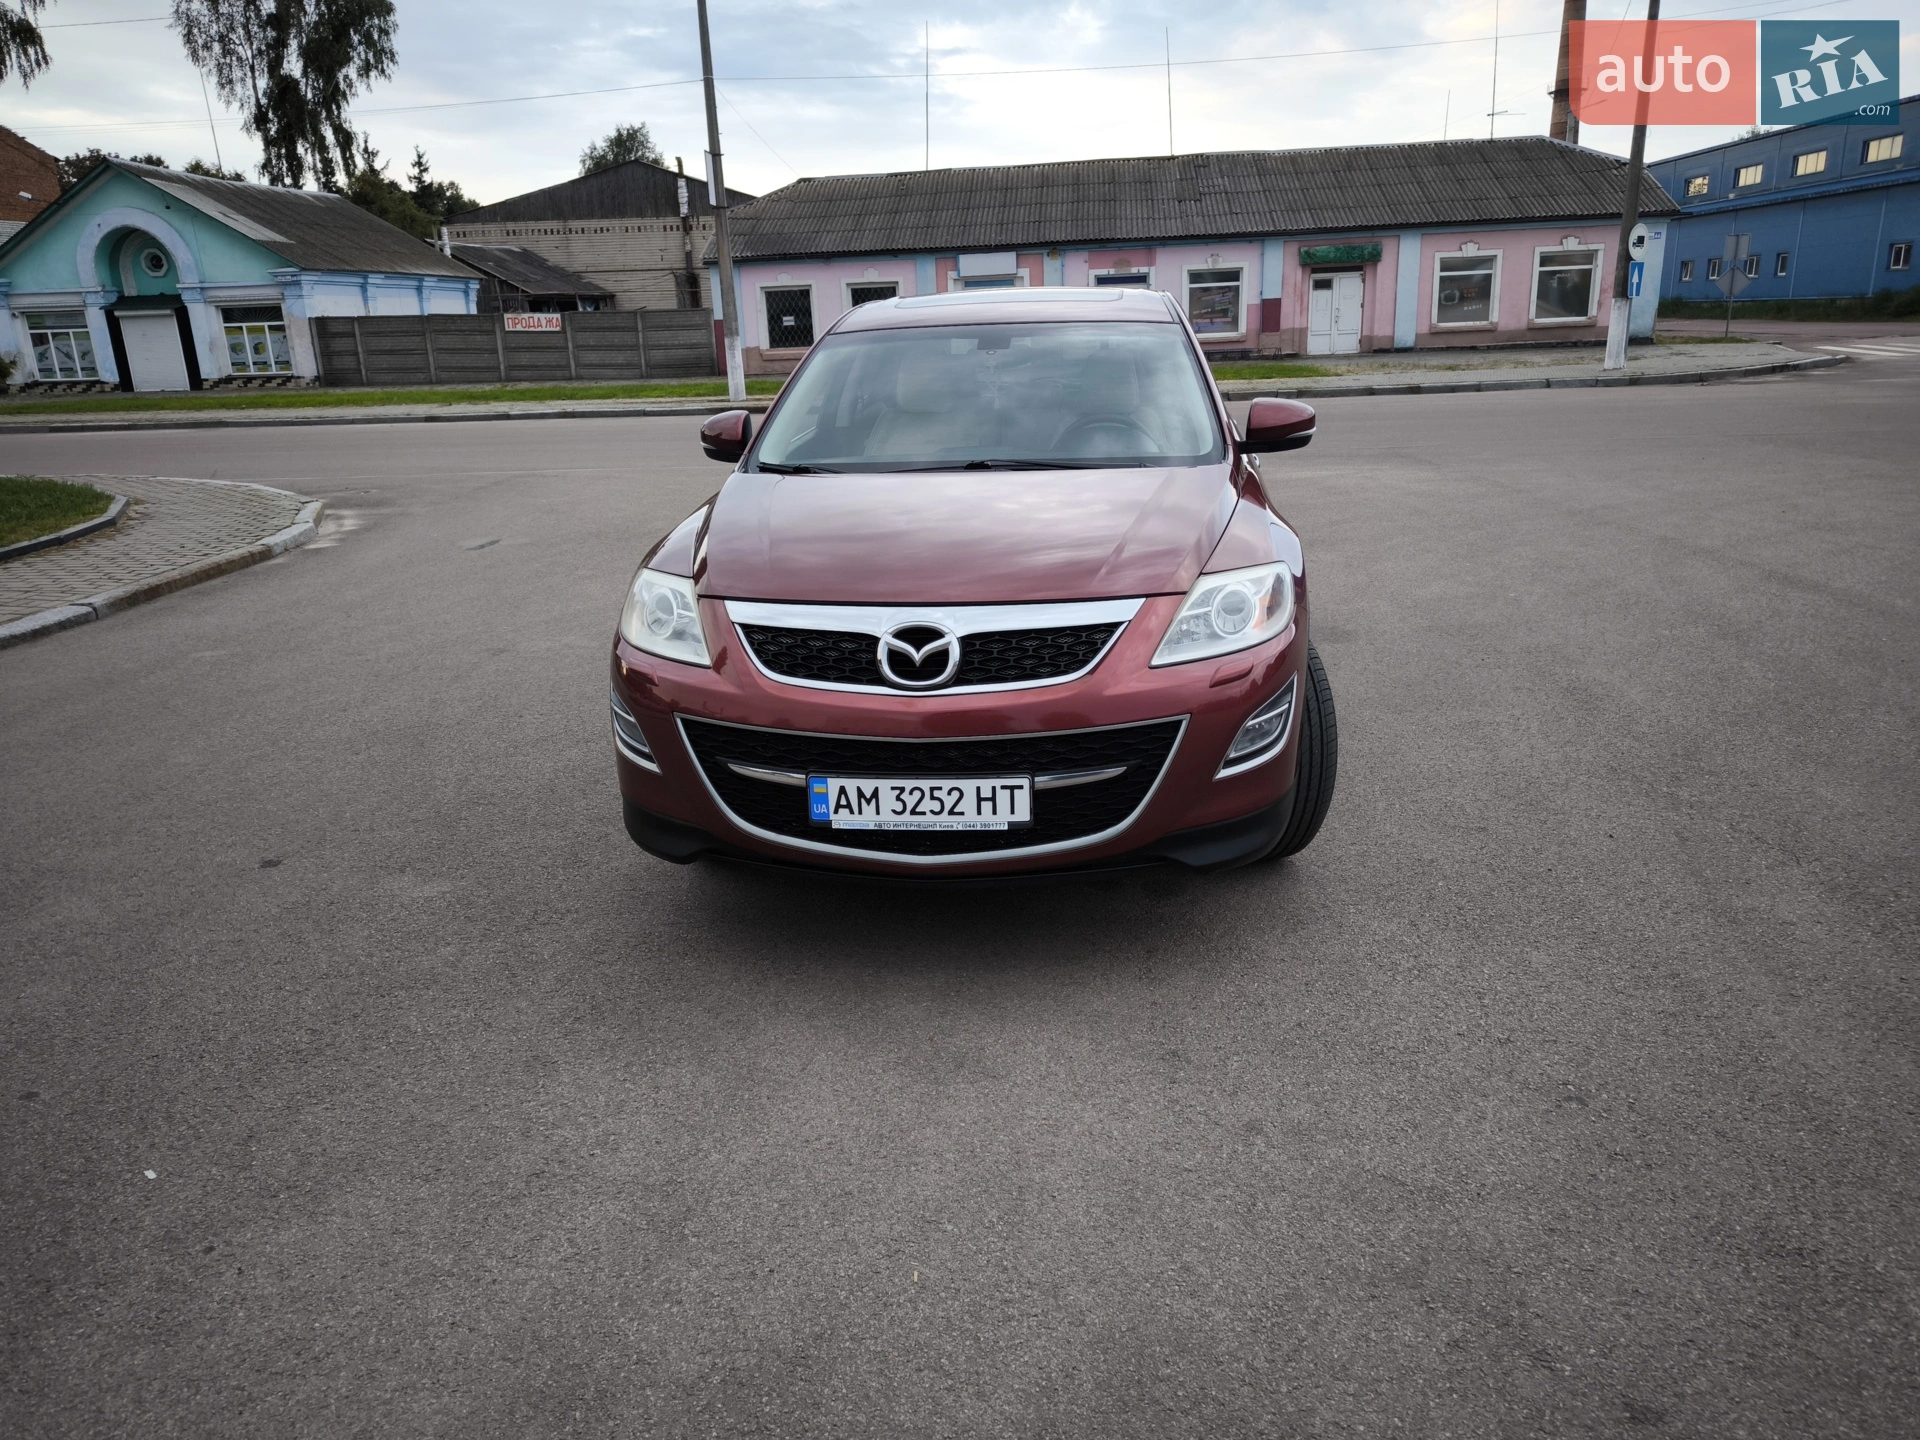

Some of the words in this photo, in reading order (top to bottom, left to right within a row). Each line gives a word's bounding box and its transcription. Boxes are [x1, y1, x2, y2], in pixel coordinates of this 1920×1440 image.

[833, 785, 880, 816] AM
[890, 786, 965, 816] 3252
[976, 785, 1024, 816] HT
[813, 803, 828, 815] UA
[961, 822, 978, 830] (044)
